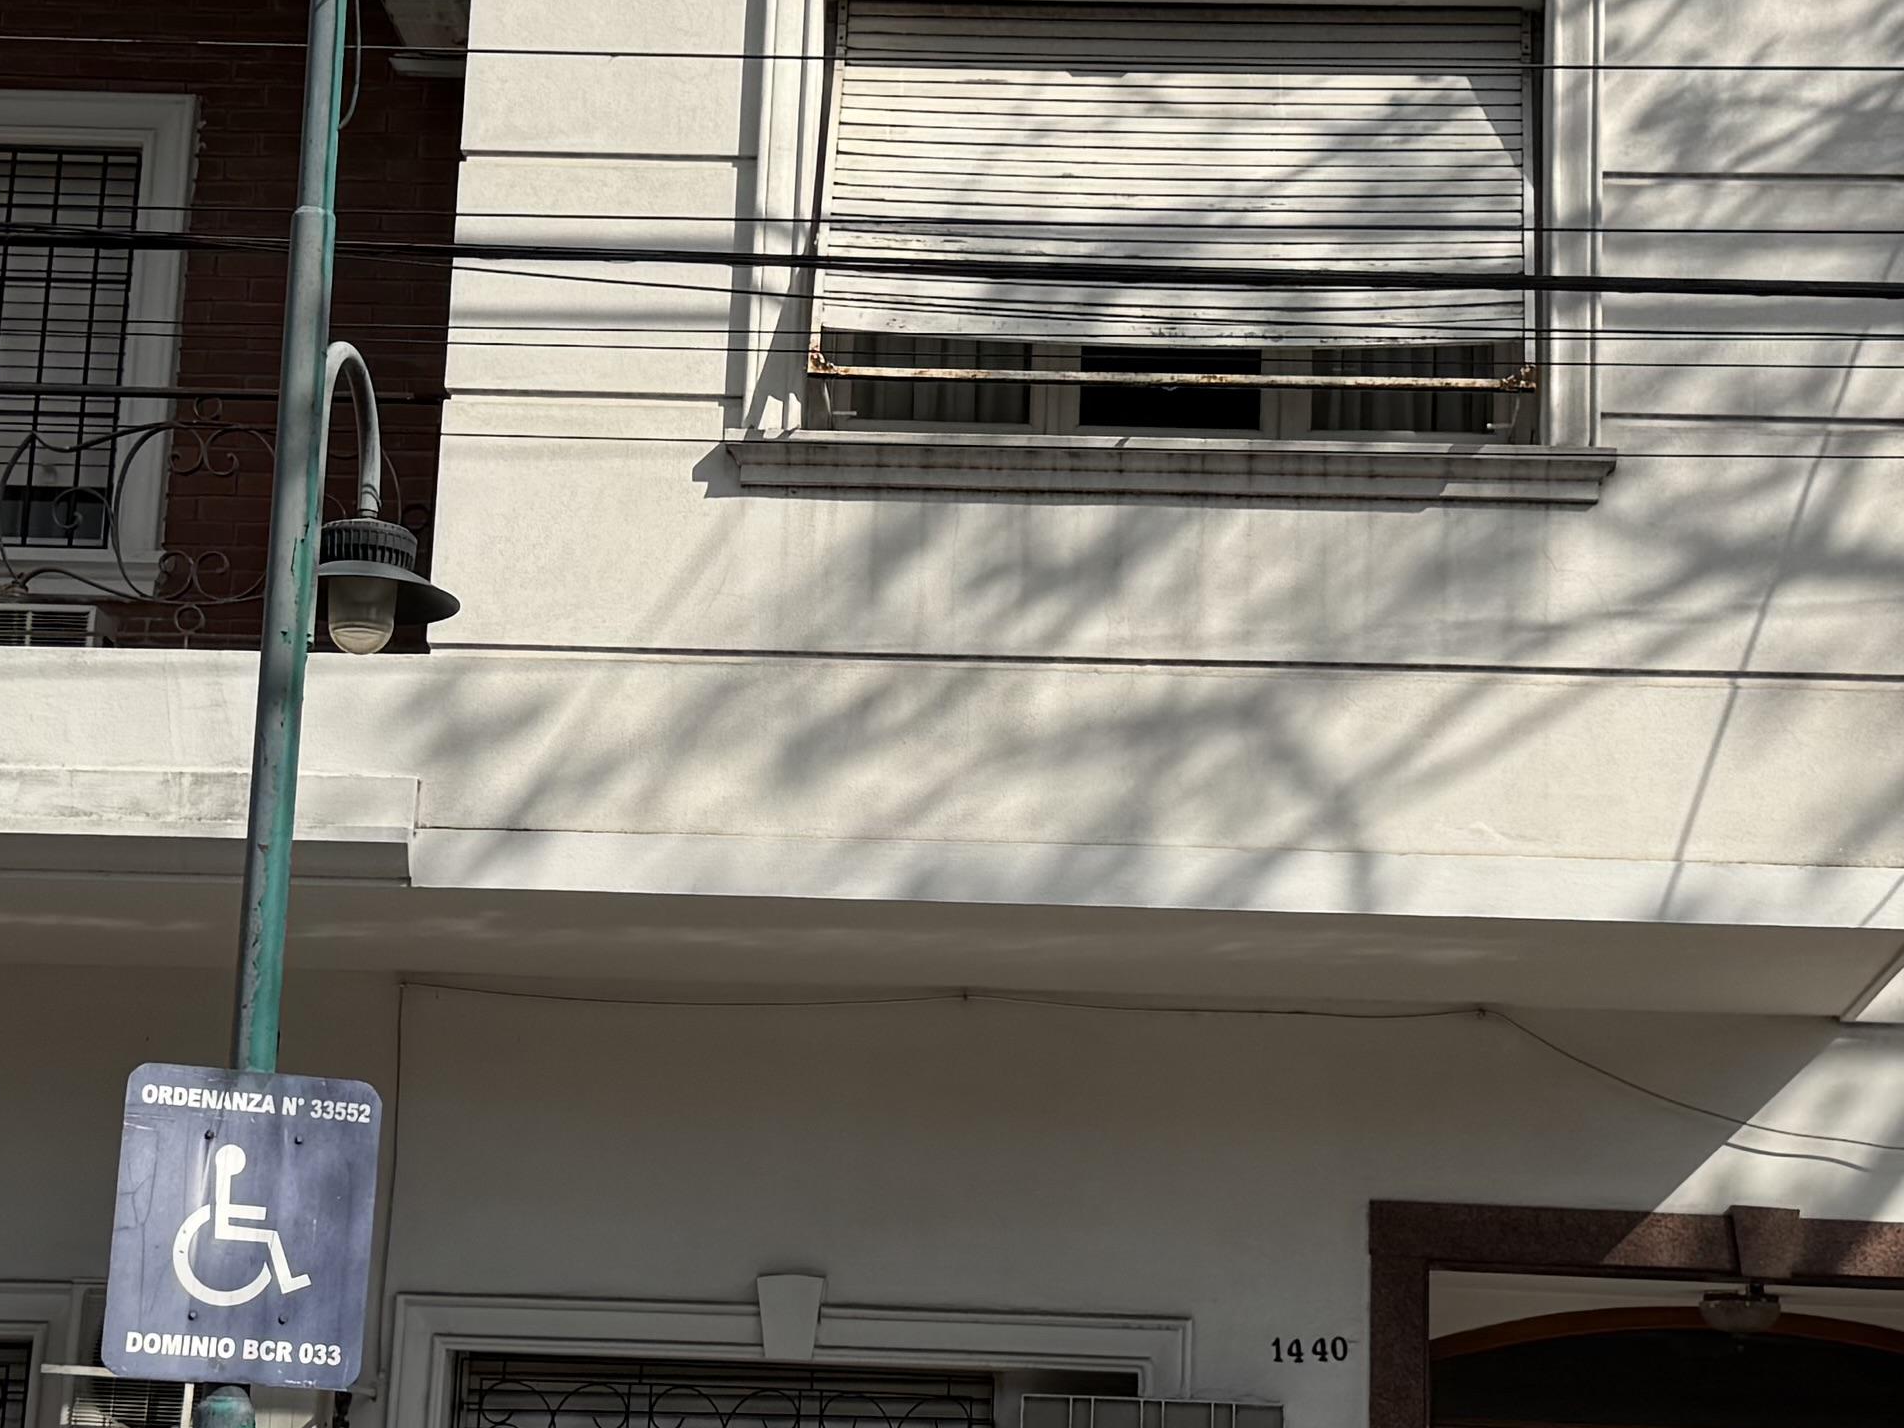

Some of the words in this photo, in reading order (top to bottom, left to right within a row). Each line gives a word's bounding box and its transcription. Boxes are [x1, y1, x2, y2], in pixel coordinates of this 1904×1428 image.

[141, 1083, 276, 1114] ORDENANZA
[309, 1099, 372, 1123] 33552
[125, 1331, 236, 1359] DOMINIO
[242, 1339, 293, 1363] BCR
[298, 1342, 342, 1366] 033
[1271, 1336, 1348, 1363] 1440
